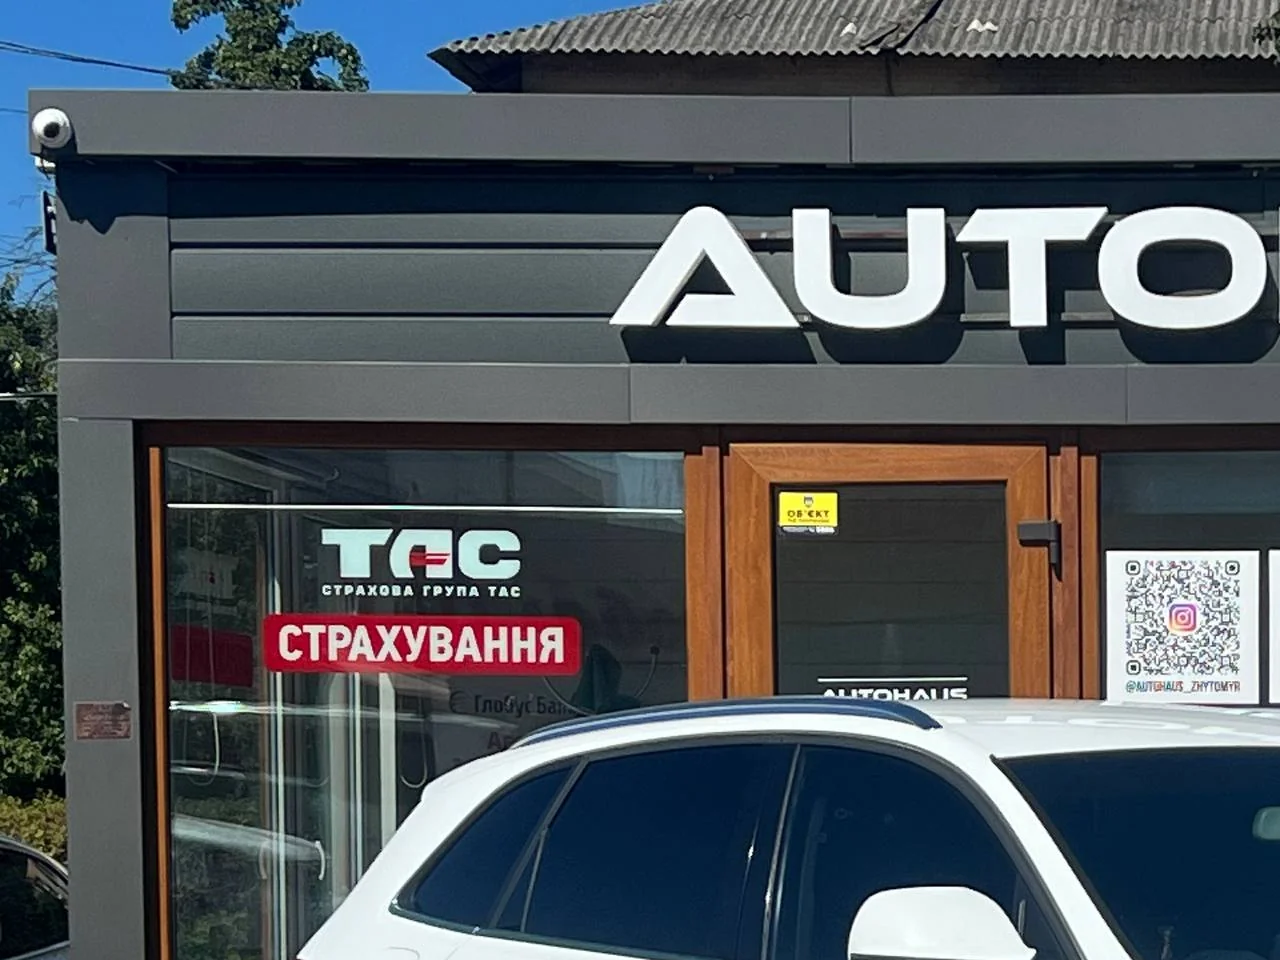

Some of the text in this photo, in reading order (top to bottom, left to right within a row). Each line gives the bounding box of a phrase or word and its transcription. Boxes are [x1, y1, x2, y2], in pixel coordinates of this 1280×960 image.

[320, 528, 521, 580] ТАС
[321, 584, 521, 598] СТРАХОВА ГРУПА ТАС
[278, 623, 565, 664] СТРАХУВАННЯ
[823, 687, 968, 700] AUTOHAUS
